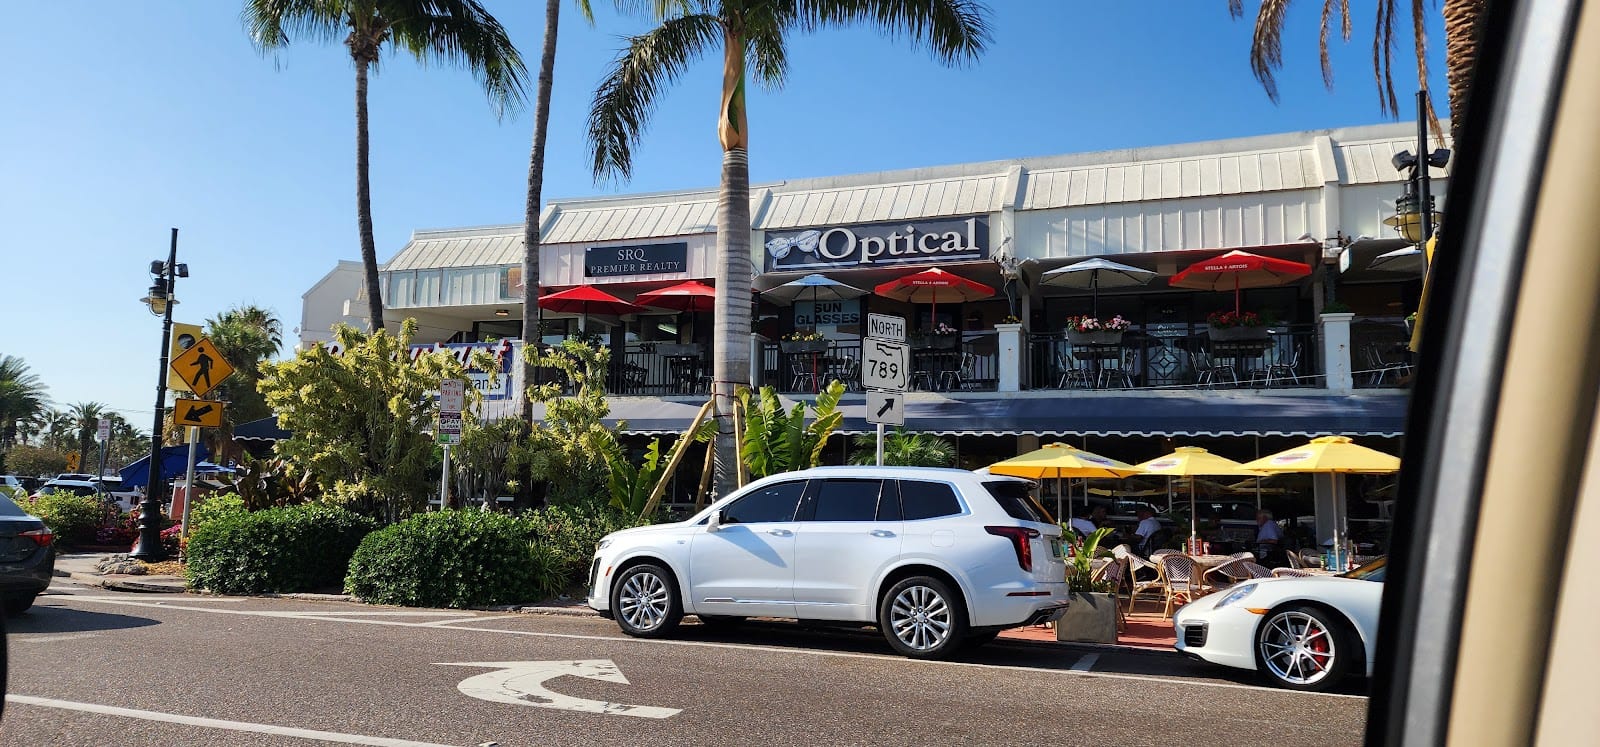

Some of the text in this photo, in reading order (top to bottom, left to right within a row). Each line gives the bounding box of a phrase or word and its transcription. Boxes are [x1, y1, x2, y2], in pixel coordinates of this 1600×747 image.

[818, 217, 980, 263] Optical
[617, 248, 648, 262] SRQ
[591, 261, 680, 274] PREMIER REALTY
[815, 302, 842, 313] SUN
[796, 312, 859, 325] GLASSES
[871, 318, 903, 337] NORTH
[868, 359, 898, 379] 789
